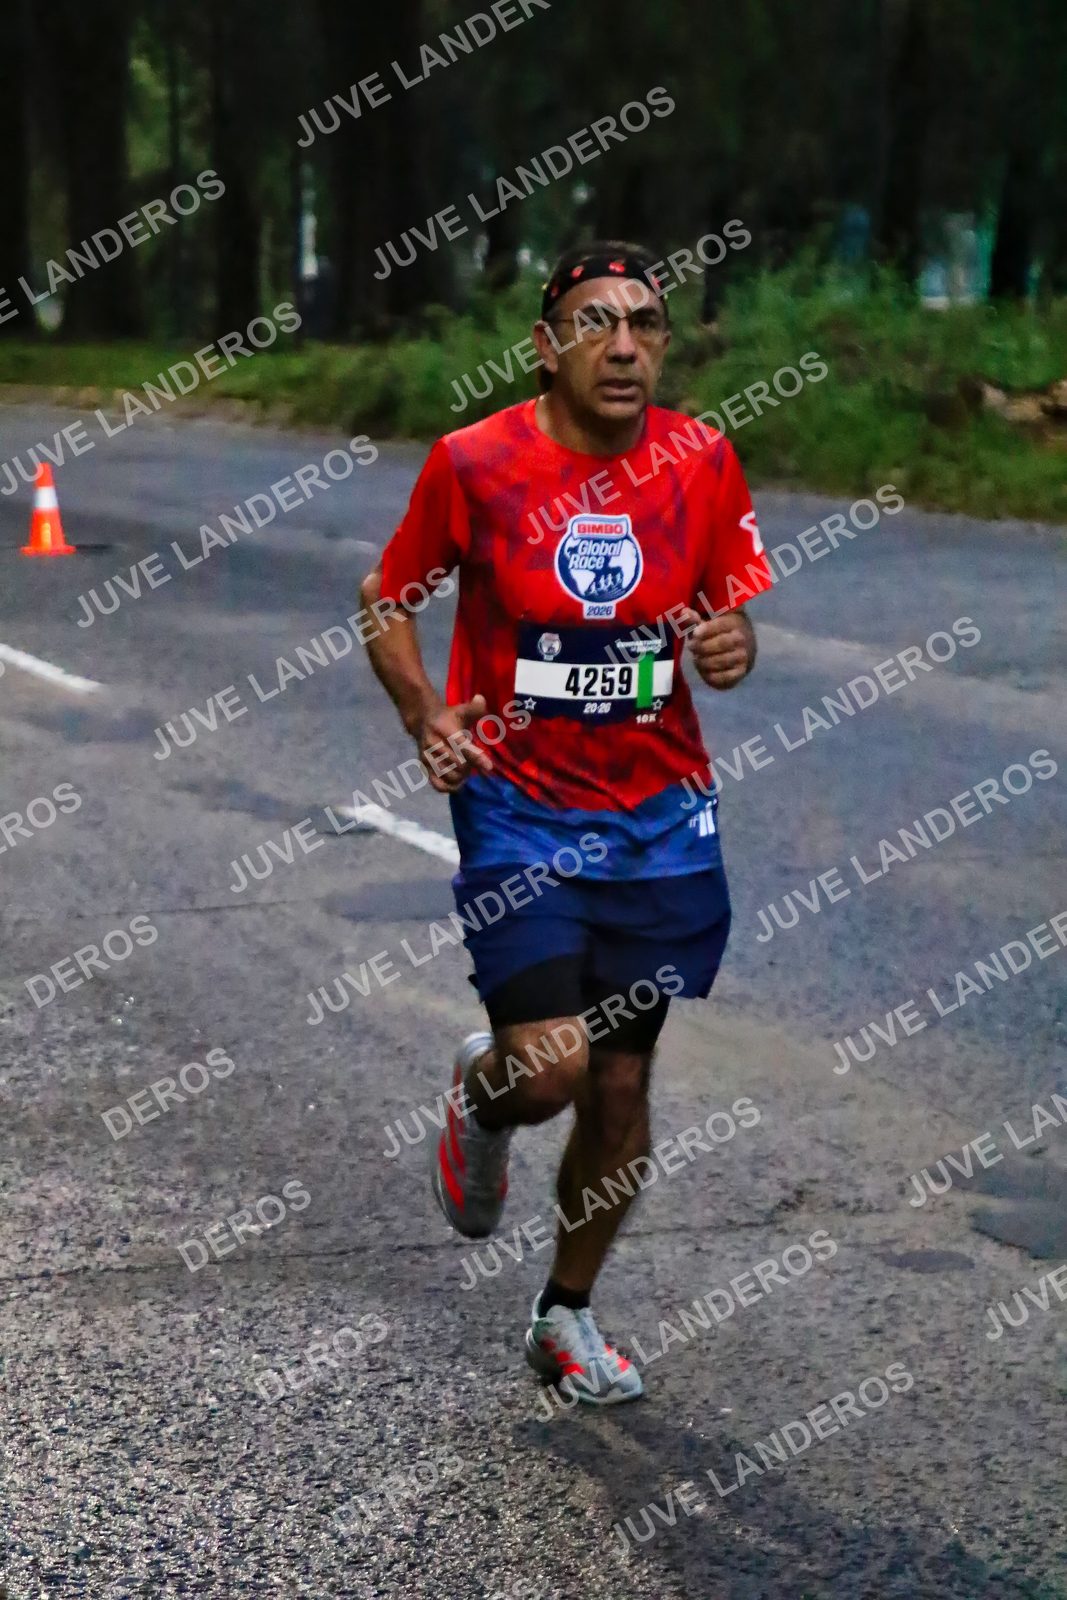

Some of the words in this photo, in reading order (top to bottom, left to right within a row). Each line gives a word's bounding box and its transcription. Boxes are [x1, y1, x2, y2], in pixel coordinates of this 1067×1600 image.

[577, 523, 624, 535] BIMBO
[578, 540, 624, 556] Global
[568, 554, 605, 570] Race
[586, 605, 614, 617] 2026
[565, 666, 634, 697] 4259
